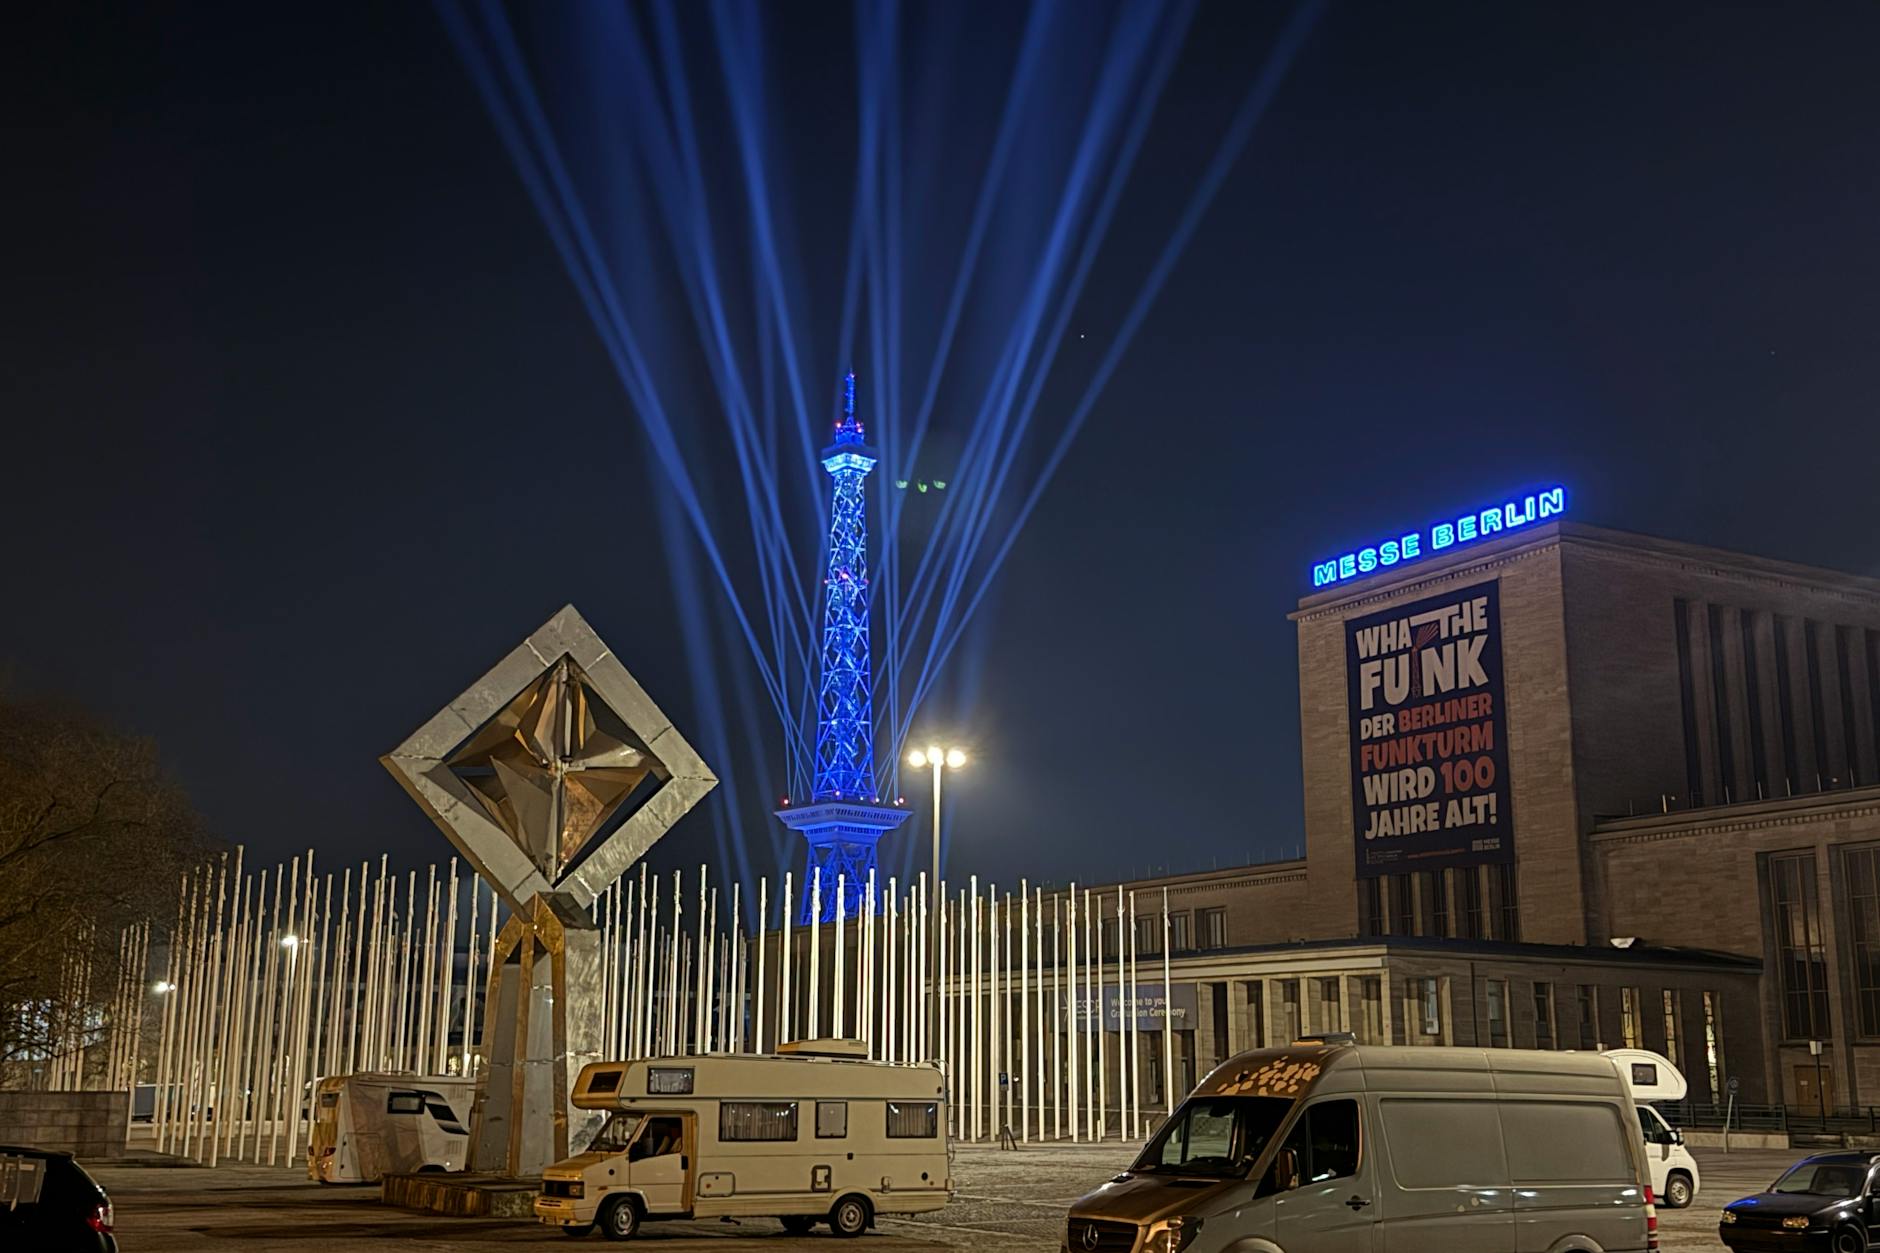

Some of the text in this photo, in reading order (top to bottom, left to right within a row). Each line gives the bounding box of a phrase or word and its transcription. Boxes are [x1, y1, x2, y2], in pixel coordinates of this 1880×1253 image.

[1313, 488, 1564, 587] MESSE BERLIN
[1360, 692, 1493, 740] DER BERLINER
[1361, 720, 1494, 772] FUNKTURM
[1363, 755, 1496, 806] WIRD 100
[1364, 792, 1497, 840] JAHRE ALT!
[1154, 998, 1167, 1008] you
